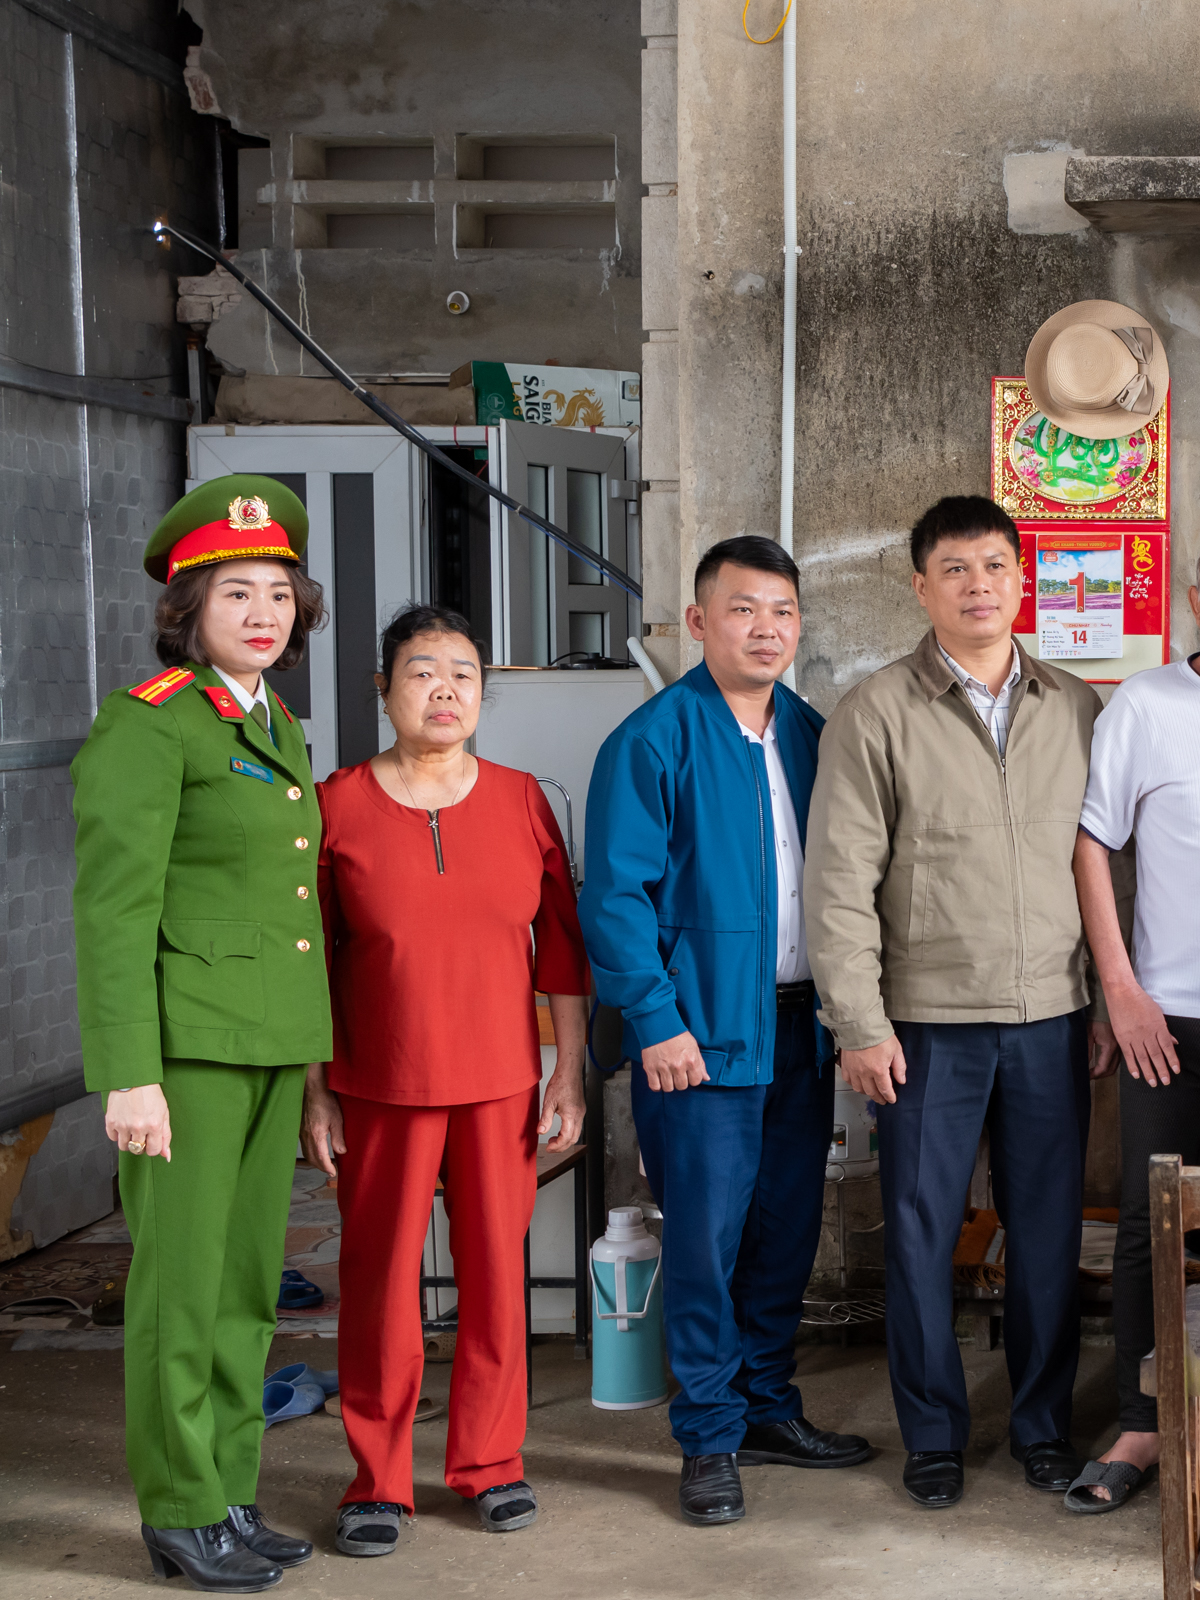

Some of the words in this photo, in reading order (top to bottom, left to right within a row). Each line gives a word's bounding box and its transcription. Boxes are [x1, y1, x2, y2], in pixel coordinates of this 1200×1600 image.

[511, 381, 523, 417] LAG
[523, 375, 540, 424] SAIG
[542, 402, 552, 425] BIA
[1069, 572, 1084, 613] 1
[1071, 630, 1087, 644] 14
